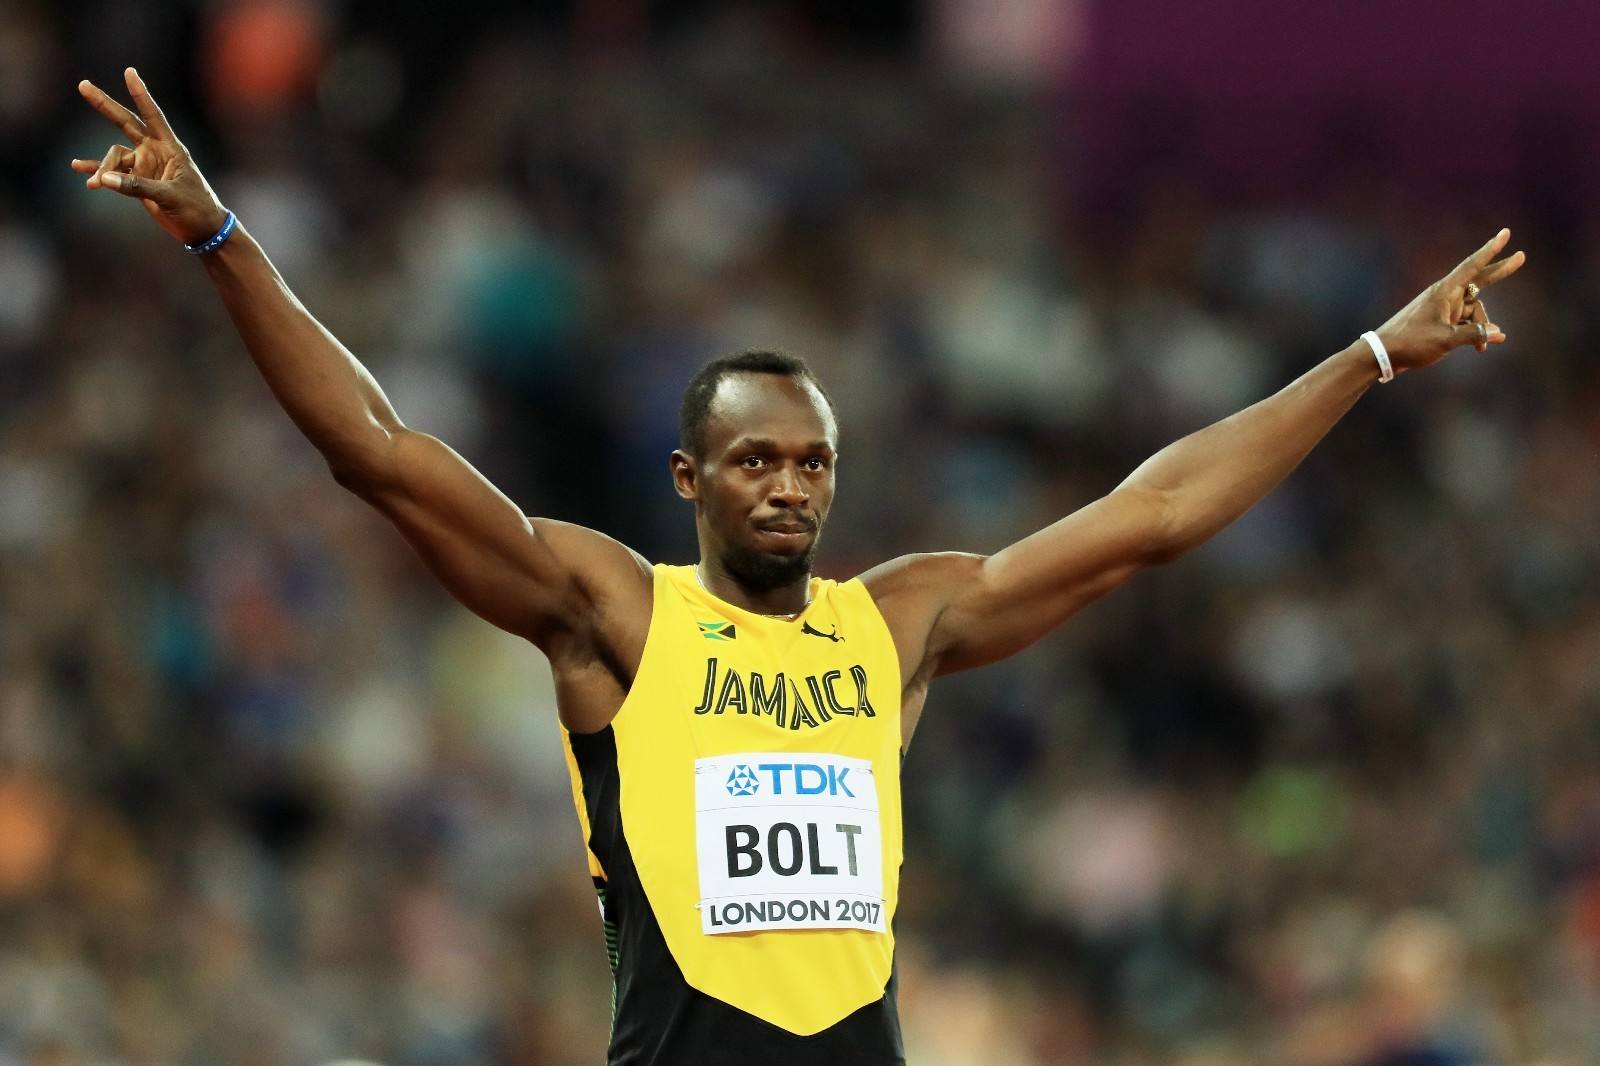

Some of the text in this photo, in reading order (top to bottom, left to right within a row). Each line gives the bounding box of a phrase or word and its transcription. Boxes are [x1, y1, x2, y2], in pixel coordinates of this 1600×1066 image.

[694, 657, 876, 730] JAMAICA
[758, 764, 856, 798] TDK
[725, 822, 862, 878] BOLT
[710, 899, 881, 926] LONDON 2017
